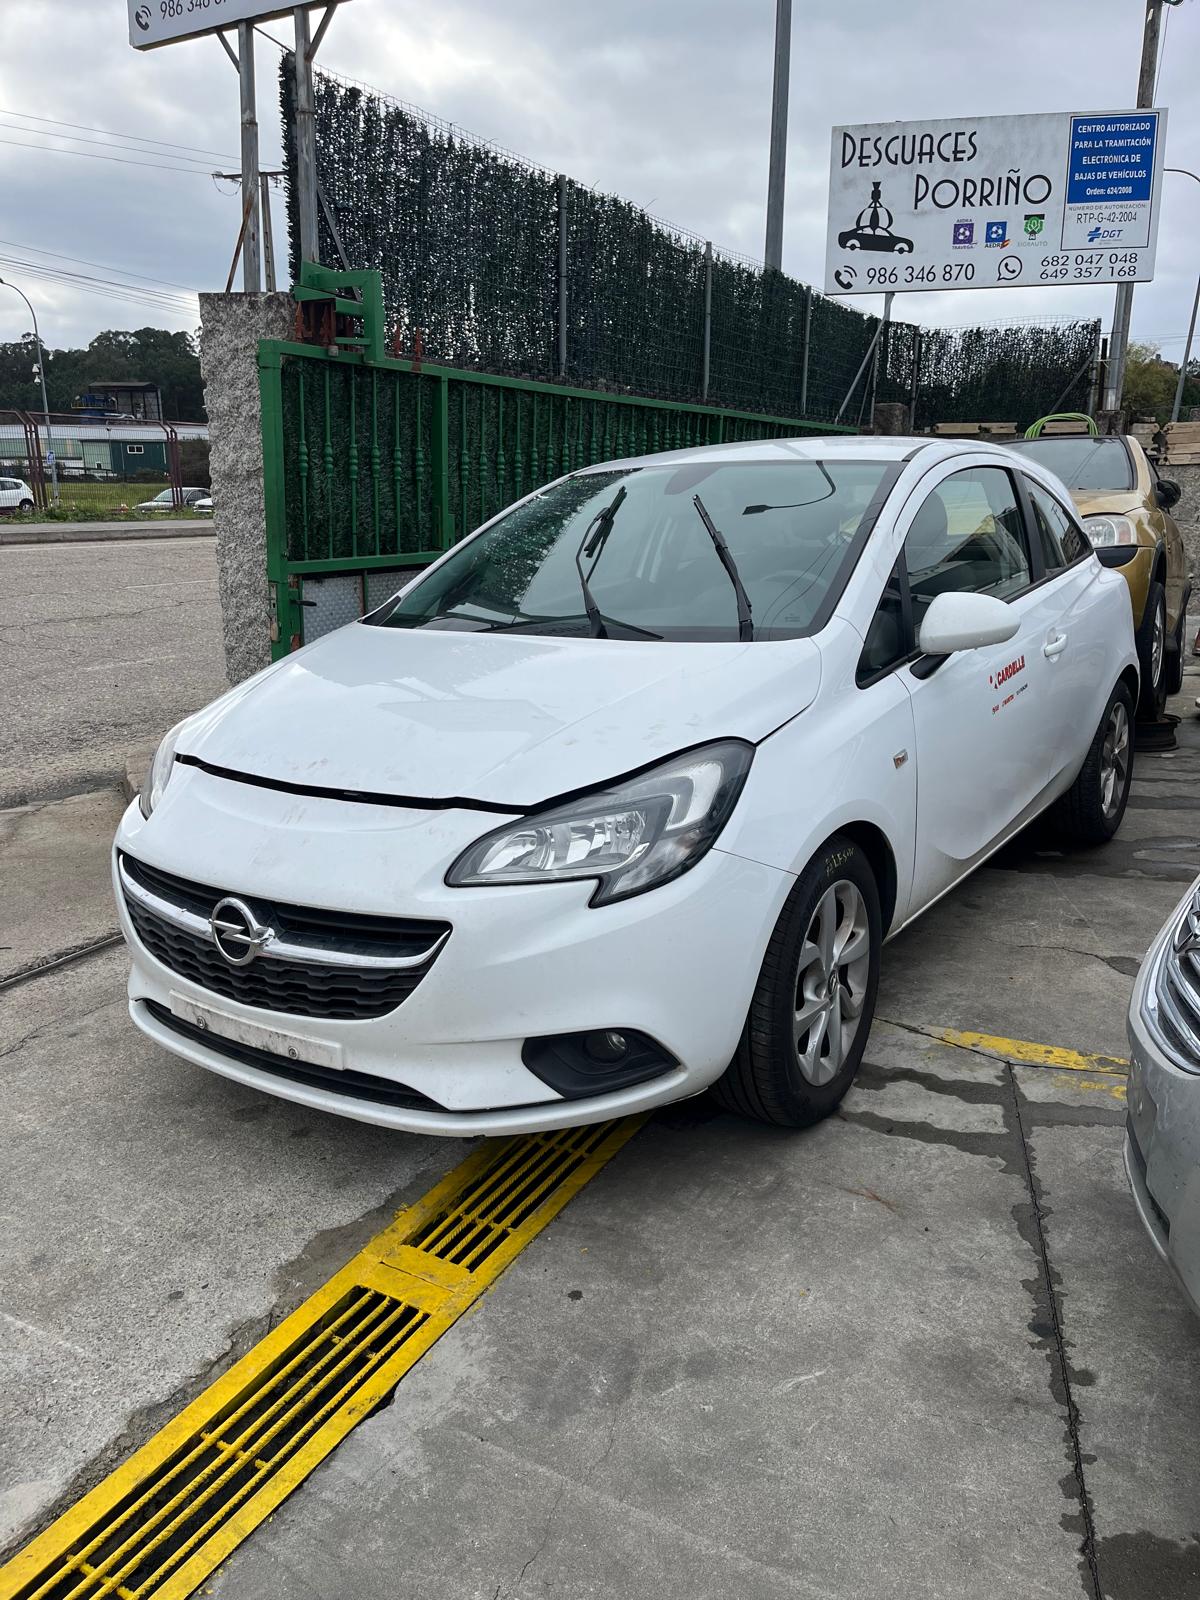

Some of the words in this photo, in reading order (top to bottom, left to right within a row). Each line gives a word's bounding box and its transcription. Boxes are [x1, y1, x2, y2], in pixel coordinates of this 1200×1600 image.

[160, 0, 183, 19] 986
[1077, 124, 1106, 134] CENTRO
[1106, 122, 1151, 132] AUTORIZADO
[1074, 140, 1093, 149] PARA
[1094, 140, 1104, 148] LA
[1104, 136, 1152, 147] TRAMITACIÓN
[841, 130, 978, 169] DESGUACES
[1082, 153, 1130, 165] ELECTRÓNICA
[1130, 154, 1141, 163] DE
[1074, 172, 1096, 181] BAJAS
[1096, 171, 1107, 180] DE
[1107, 168, 1147, 179] VEHÍCULOS
[913, 168, 1053, 210] PORRIÑO
[1085, 187, 1106, 196] Orden:
[1106, 185, 1133, 195] 624/2008
[1076, 211, 1137, 224] RTP-G-42-2004
[1101, 229, 1124, 239] DGT
[1041, 255, 1070, 267] 682
[1074, 253, 1104, 266] 047
[1109, 252, 1138, 264] 048
[866, 266, 898, 285] 986
[904, 265, 936, 283] 346
[942, 263, 975, 282] 870
[1039, 267, 1069, 280] 649
[1073, 266, 1103, 278] 357
[1109, 265, 1137, 277] 168
